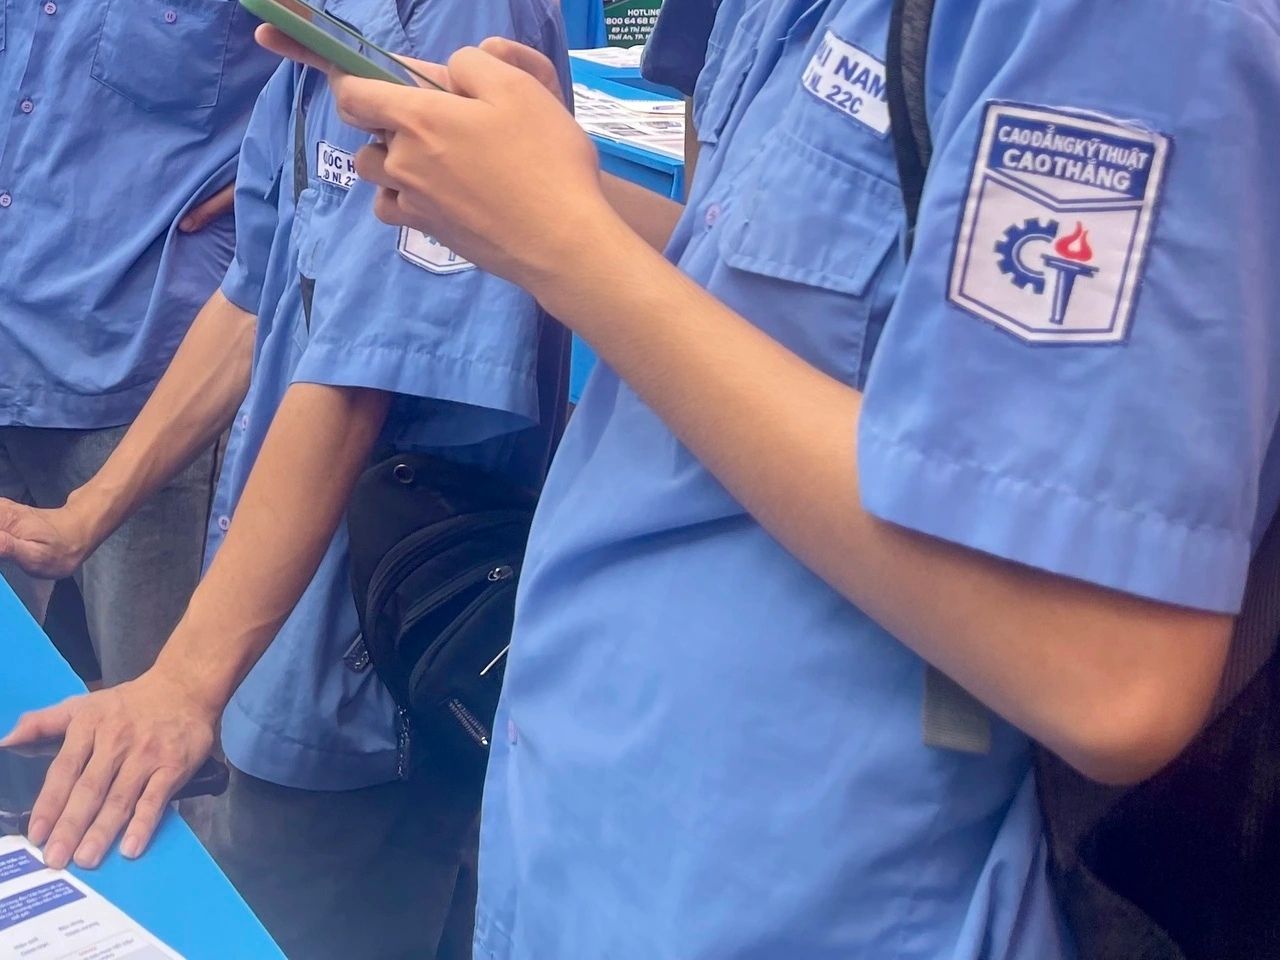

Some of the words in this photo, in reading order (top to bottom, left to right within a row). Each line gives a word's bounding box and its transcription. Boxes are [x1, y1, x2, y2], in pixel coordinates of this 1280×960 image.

[605, 17, 623, 25] 800
[825, 84, 863, 115] 22C
[1002, 148, 1052, 173] CAO
[332, 171, 342, 184] NL
